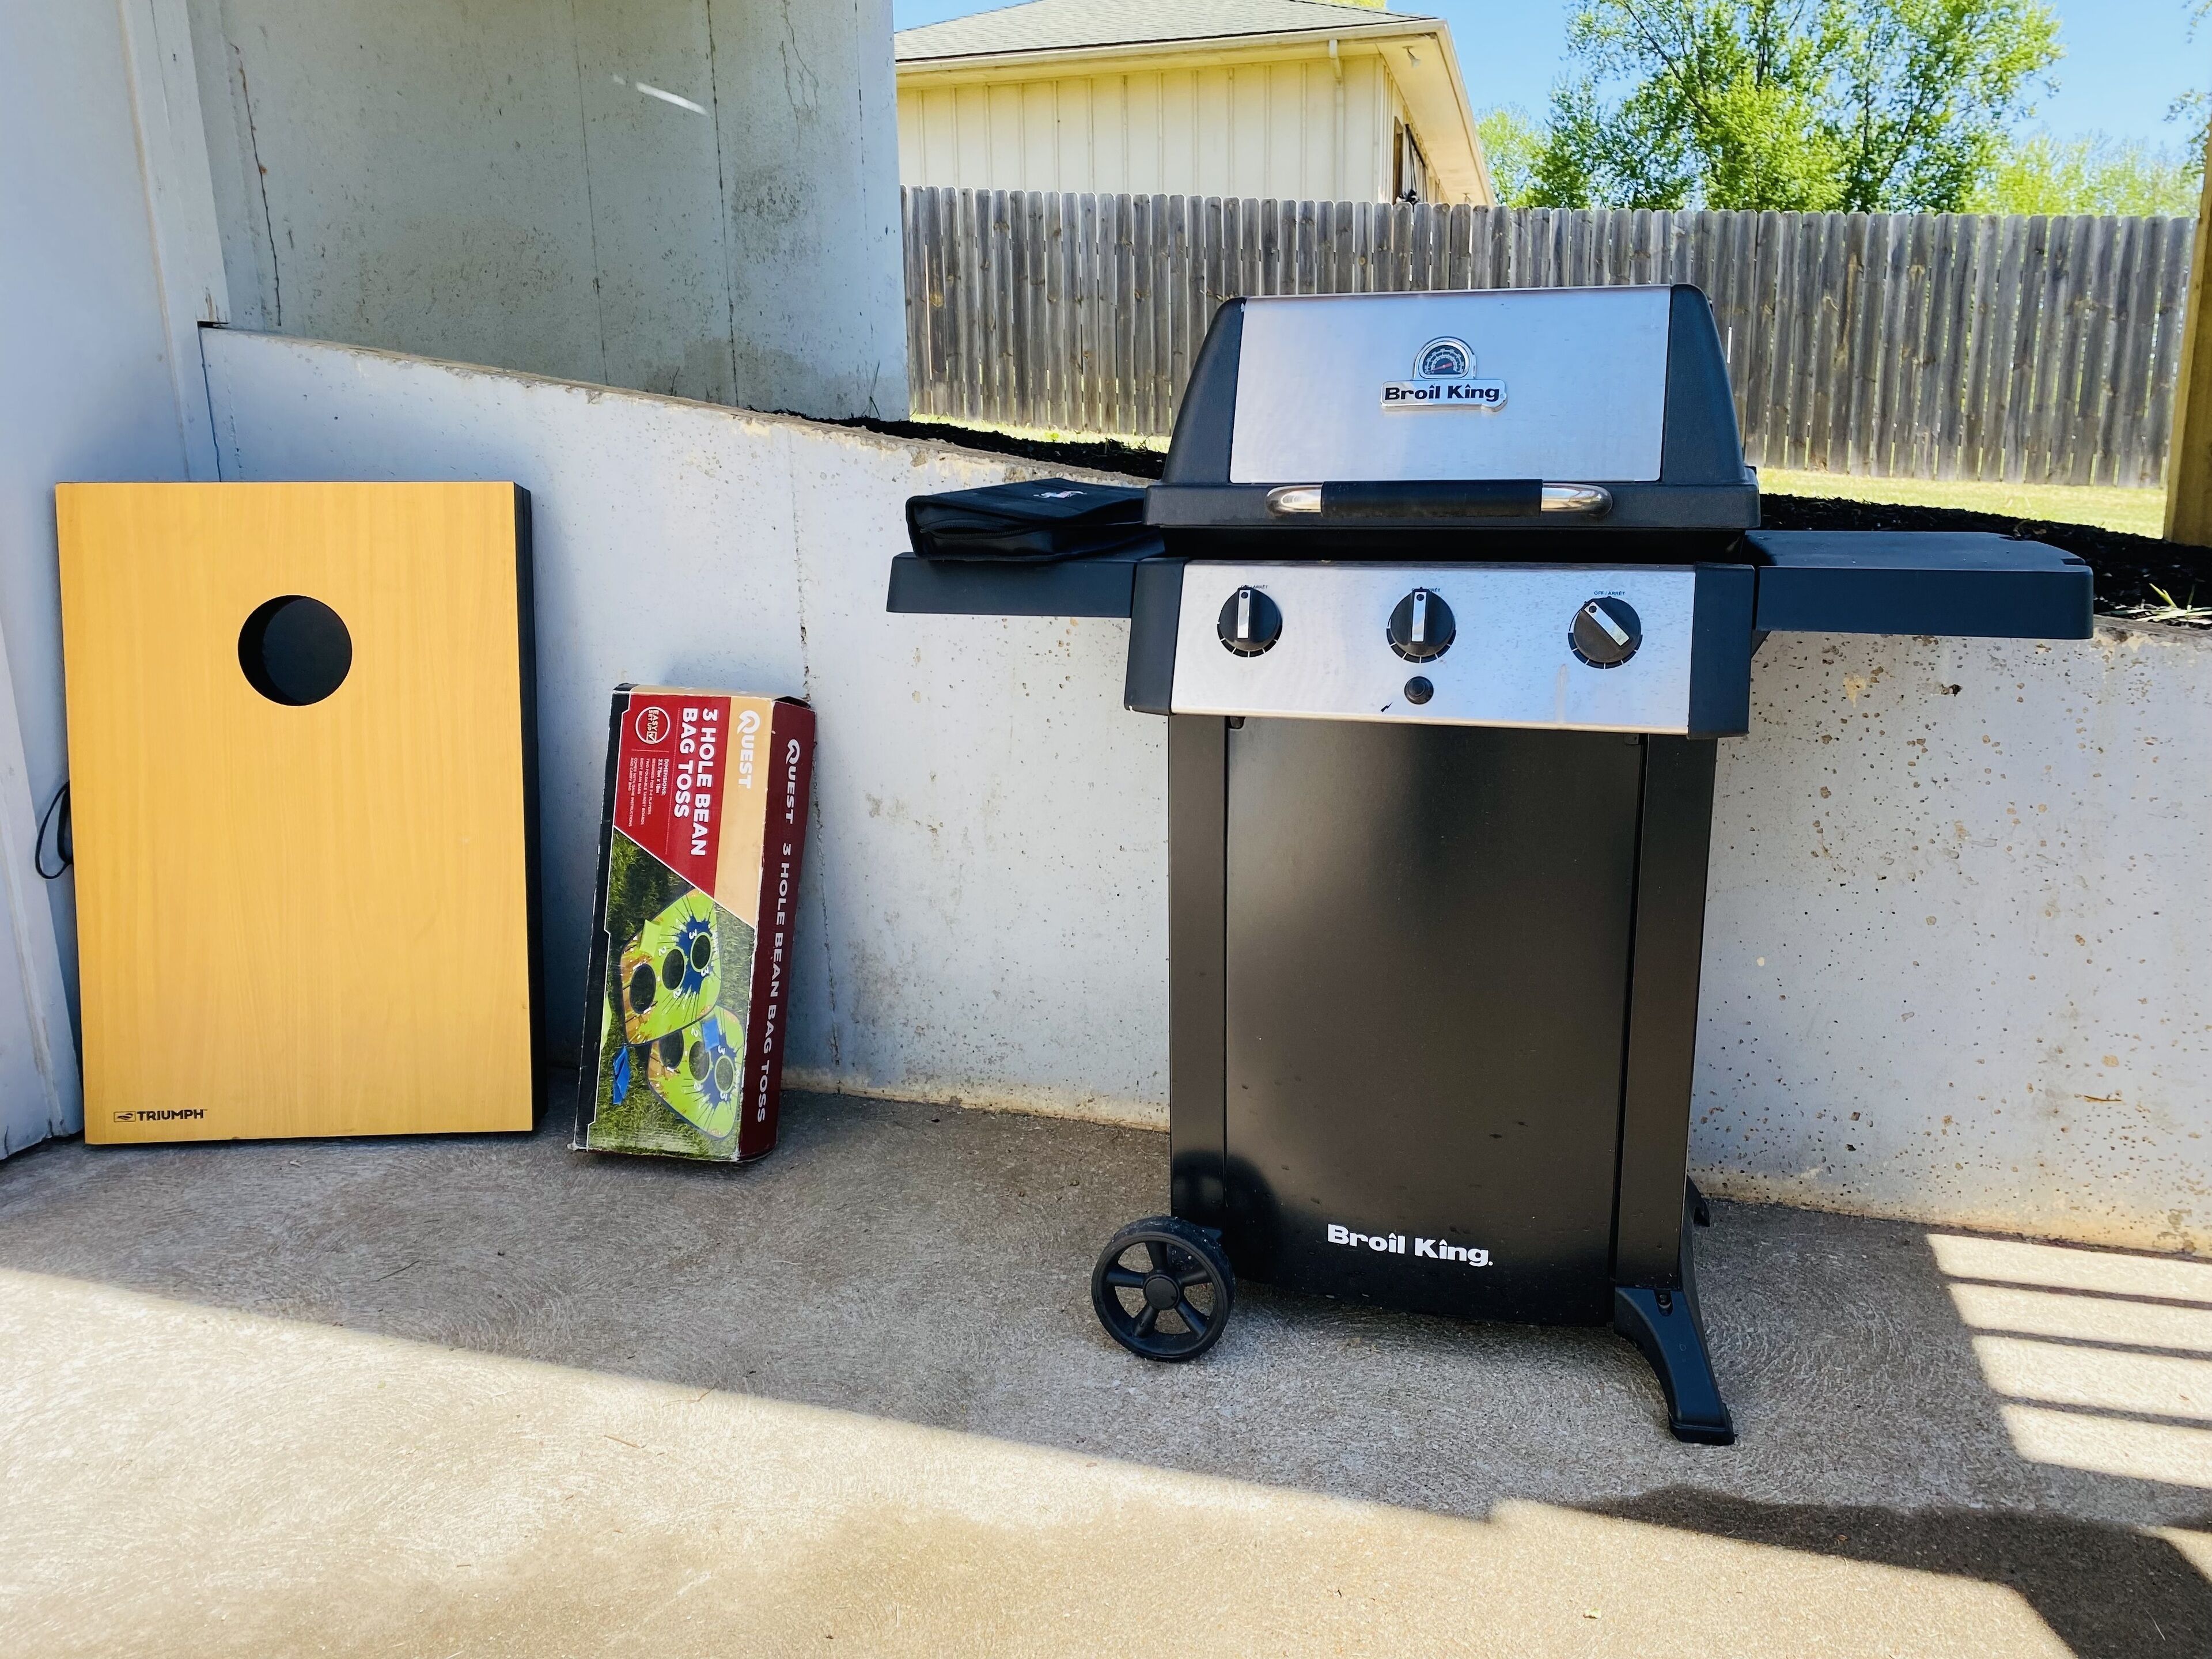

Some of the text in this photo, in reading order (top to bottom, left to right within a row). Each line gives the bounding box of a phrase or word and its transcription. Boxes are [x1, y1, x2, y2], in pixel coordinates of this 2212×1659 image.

[652, 710, 660, 731] EASY
[647, 722, 652, 731] UP
[737, 710, 760, 789] QUEST
[674, 707, 698, 818] BAG TOSS
[690, 708, 718, 856] 3 HOLE BEAN
[688, 929, 698, 940] 3
[757, 738, 800, 1123] QUEST 3 HOLE BEAN BAG TOSS
[658, 946, 666, 956] 2
[700, 966, 709, 977] 3
[673, 989, 681, 999] 2
[691, 1028, 698, 1037] 2
[718, 1045, 726, 1055] 3
[137, 1109, 204, 1121] TRIUMPH
